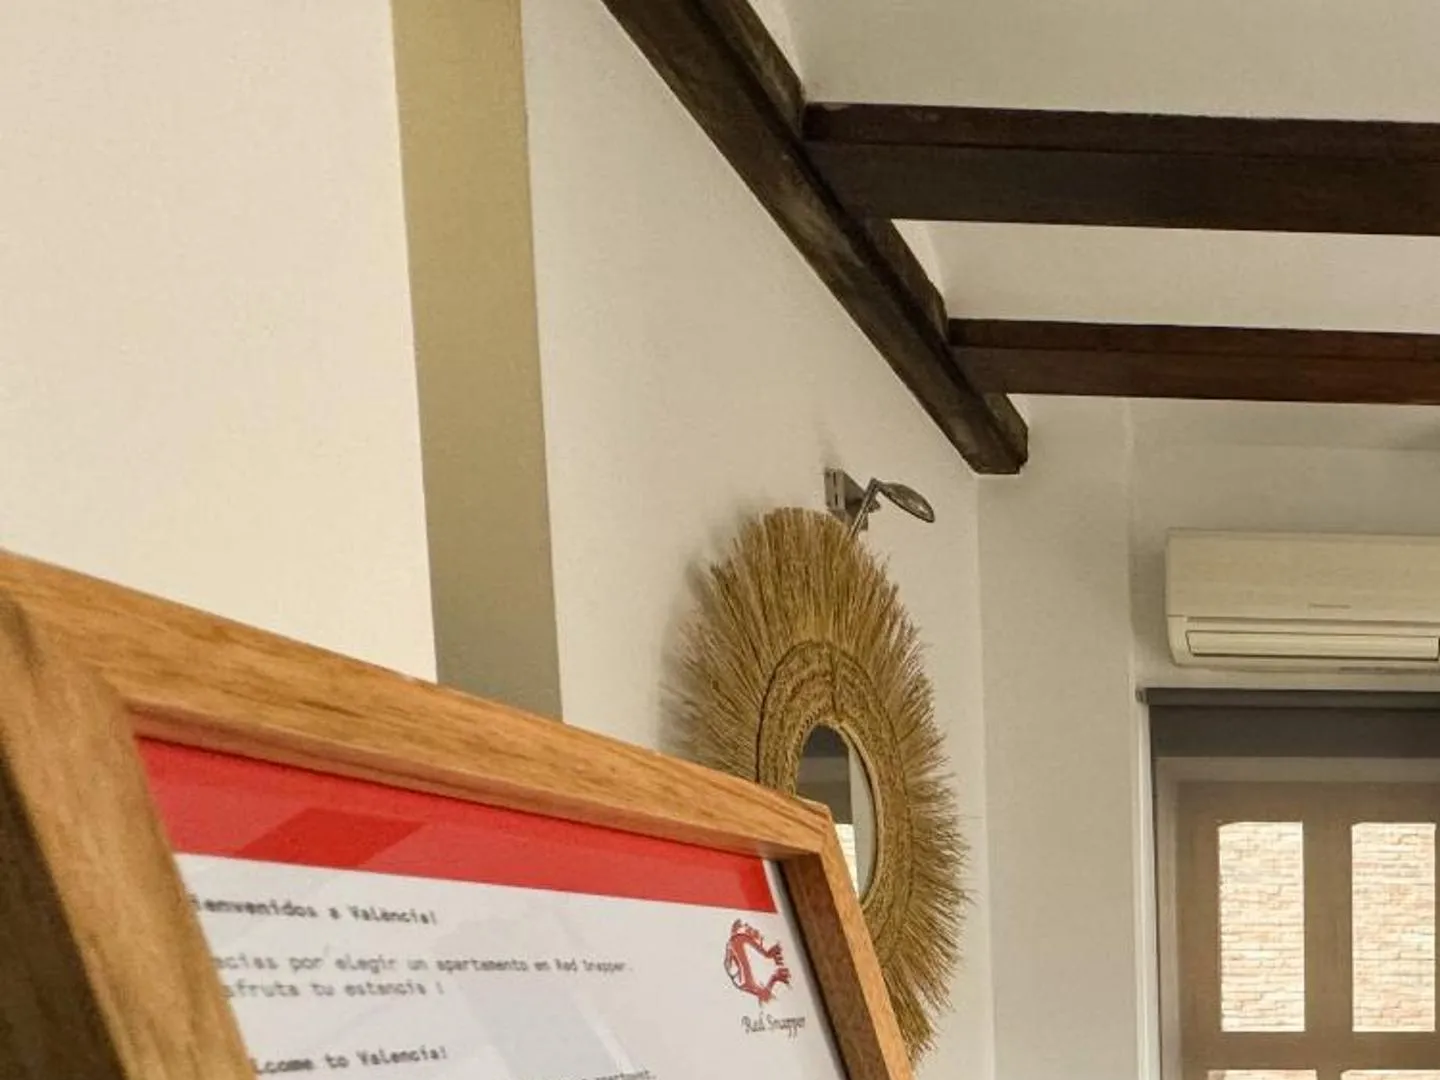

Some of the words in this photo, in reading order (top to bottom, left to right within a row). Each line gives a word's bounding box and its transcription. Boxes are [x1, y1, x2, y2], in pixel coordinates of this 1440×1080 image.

[190, 893, 318, 918] ienvenidos
[288, 956, 324, 973] por
[251, 1057, 315, 1075] lcome
[325, 1053, 350, 1070] to
